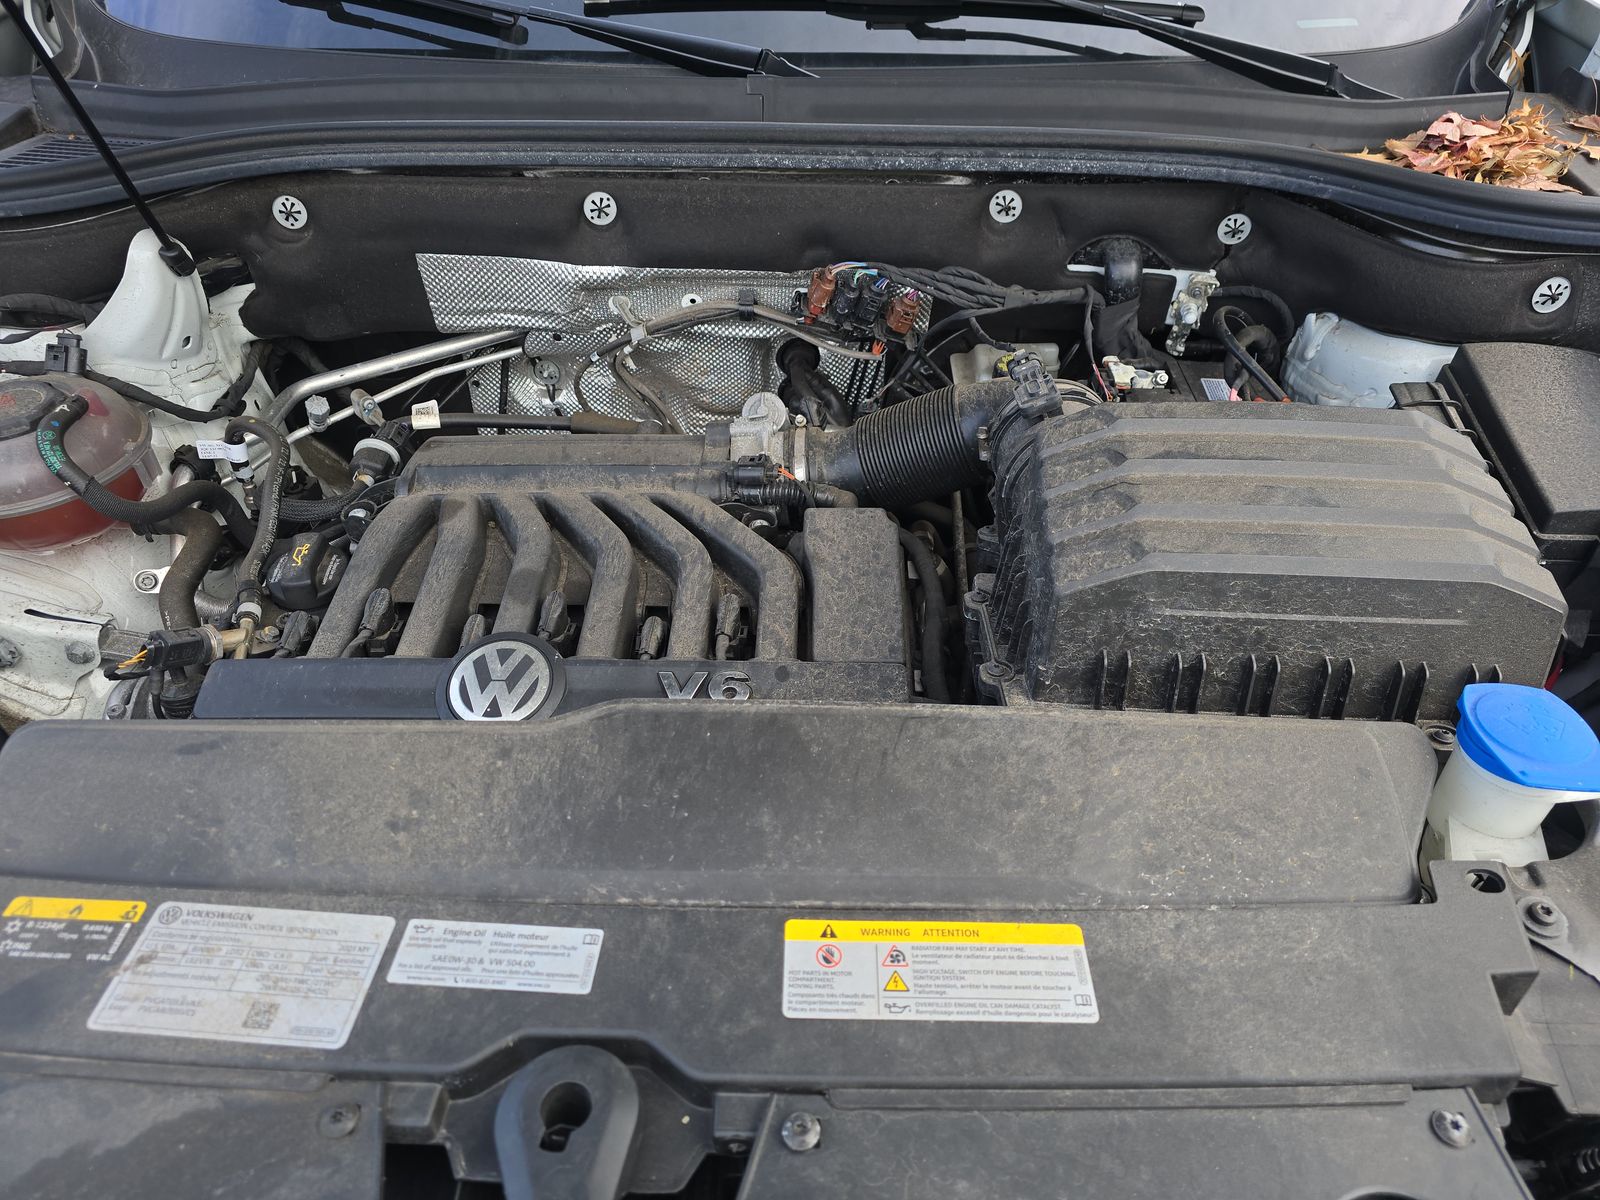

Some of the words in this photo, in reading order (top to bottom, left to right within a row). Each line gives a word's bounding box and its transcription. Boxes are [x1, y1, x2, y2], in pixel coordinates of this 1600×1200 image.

[658, 670, 750, 700] V6
[186, 909, 254, 922] VOLKSWAGEN
[442, 928, 473, 938] Engine
[473, 928, 488, 938] Oil
[493, 930, 516, 940] Huile
[517, 933, 549, 941] moteur
[860, 928, 911, 937] WARNING
[922, 928, 980, 938] ATTENTION
[506, 958, 536, 968] 504.00
